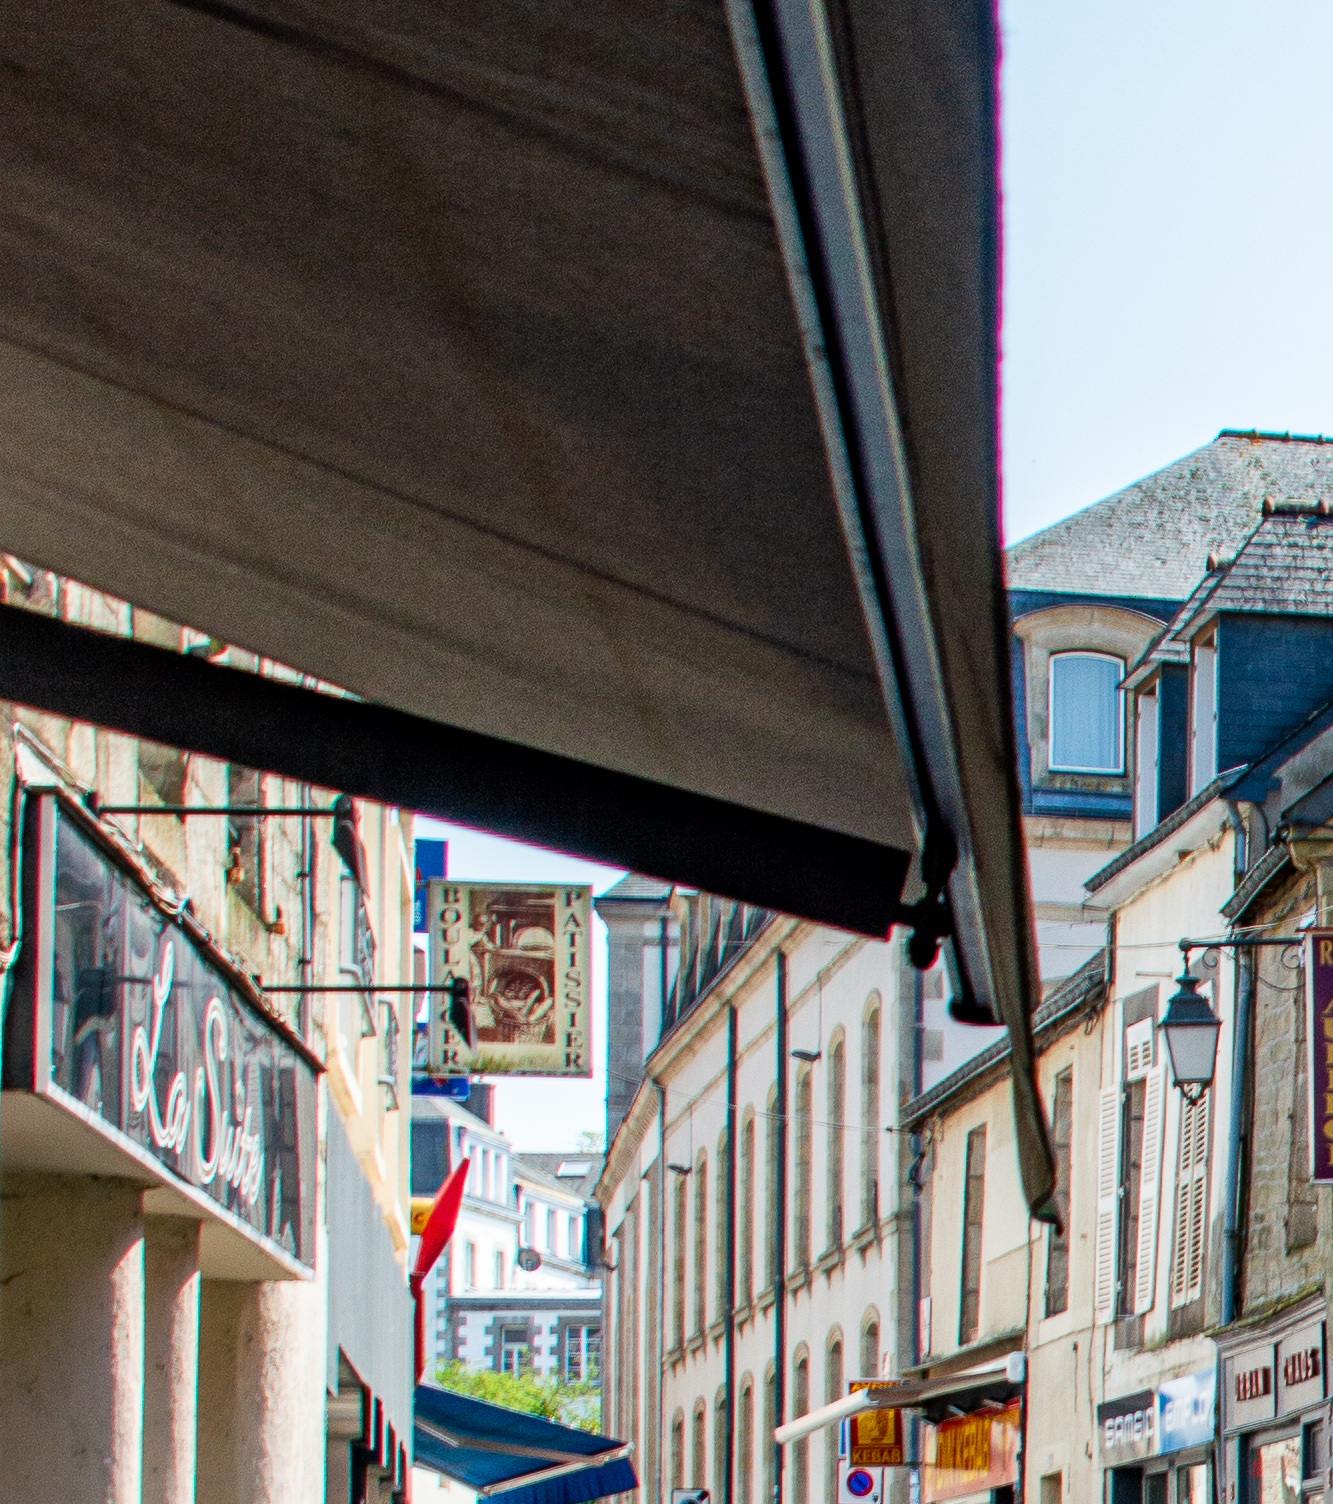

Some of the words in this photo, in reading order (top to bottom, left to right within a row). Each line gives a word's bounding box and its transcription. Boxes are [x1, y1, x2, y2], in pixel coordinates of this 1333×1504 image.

[563, 890, 583, 1069] PATISSIER
[131, 940, 192, 1156] La
[193, 996, 266, 1206] Suite
[853, 1448, 901, 1463] KEBAB
